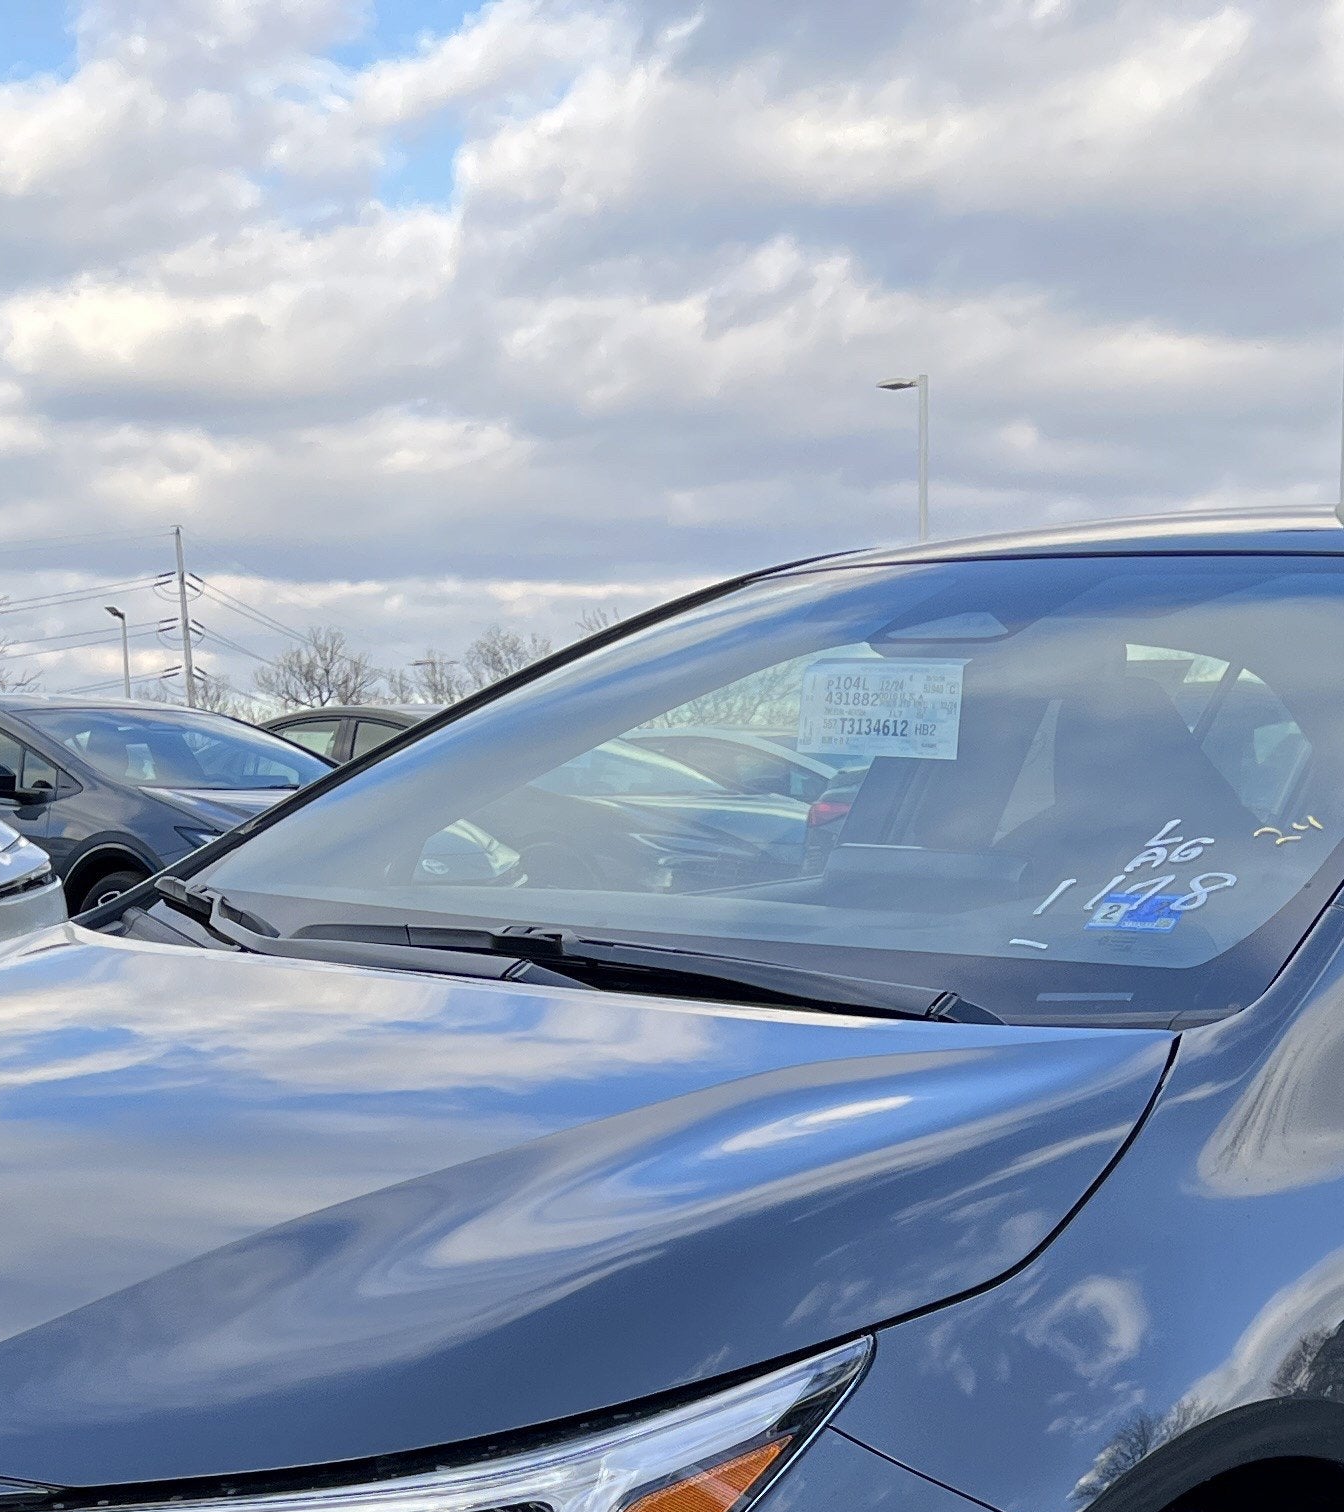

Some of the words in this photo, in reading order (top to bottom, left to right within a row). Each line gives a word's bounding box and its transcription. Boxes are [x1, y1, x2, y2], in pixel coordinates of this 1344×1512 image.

[826, 676, 870, 691] P104L
[826, 691, 880, 707] 431882
[840, 717, 909, 737] T3134612
[914, 723, 937, 737] HB2
